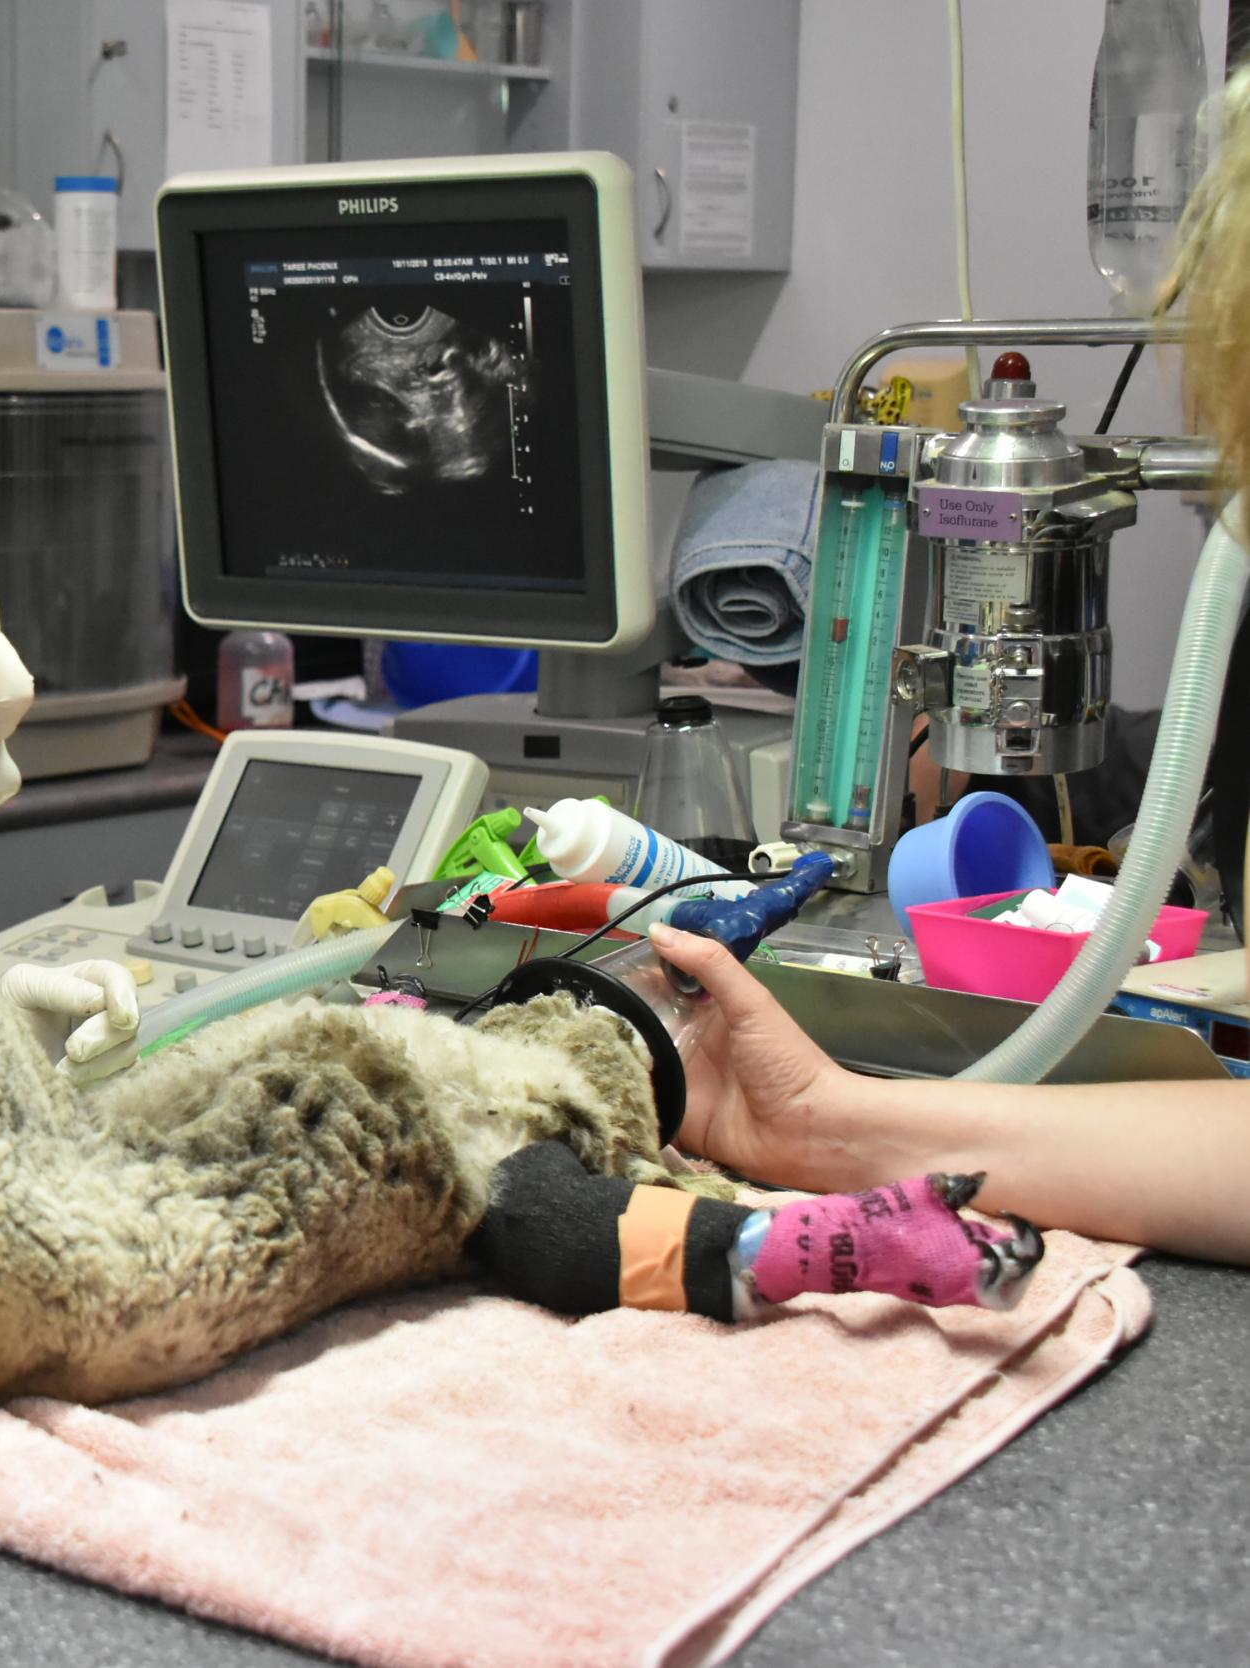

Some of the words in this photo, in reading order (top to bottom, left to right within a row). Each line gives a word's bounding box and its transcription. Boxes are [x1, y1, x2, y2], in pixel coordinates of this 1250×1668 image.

[338, 197, 399, 215] PHILIPS
[939, 498, 962, 511] Use
[965, 501, 995, 515] Only
[938, 513, 998, 529] Isoflurane
